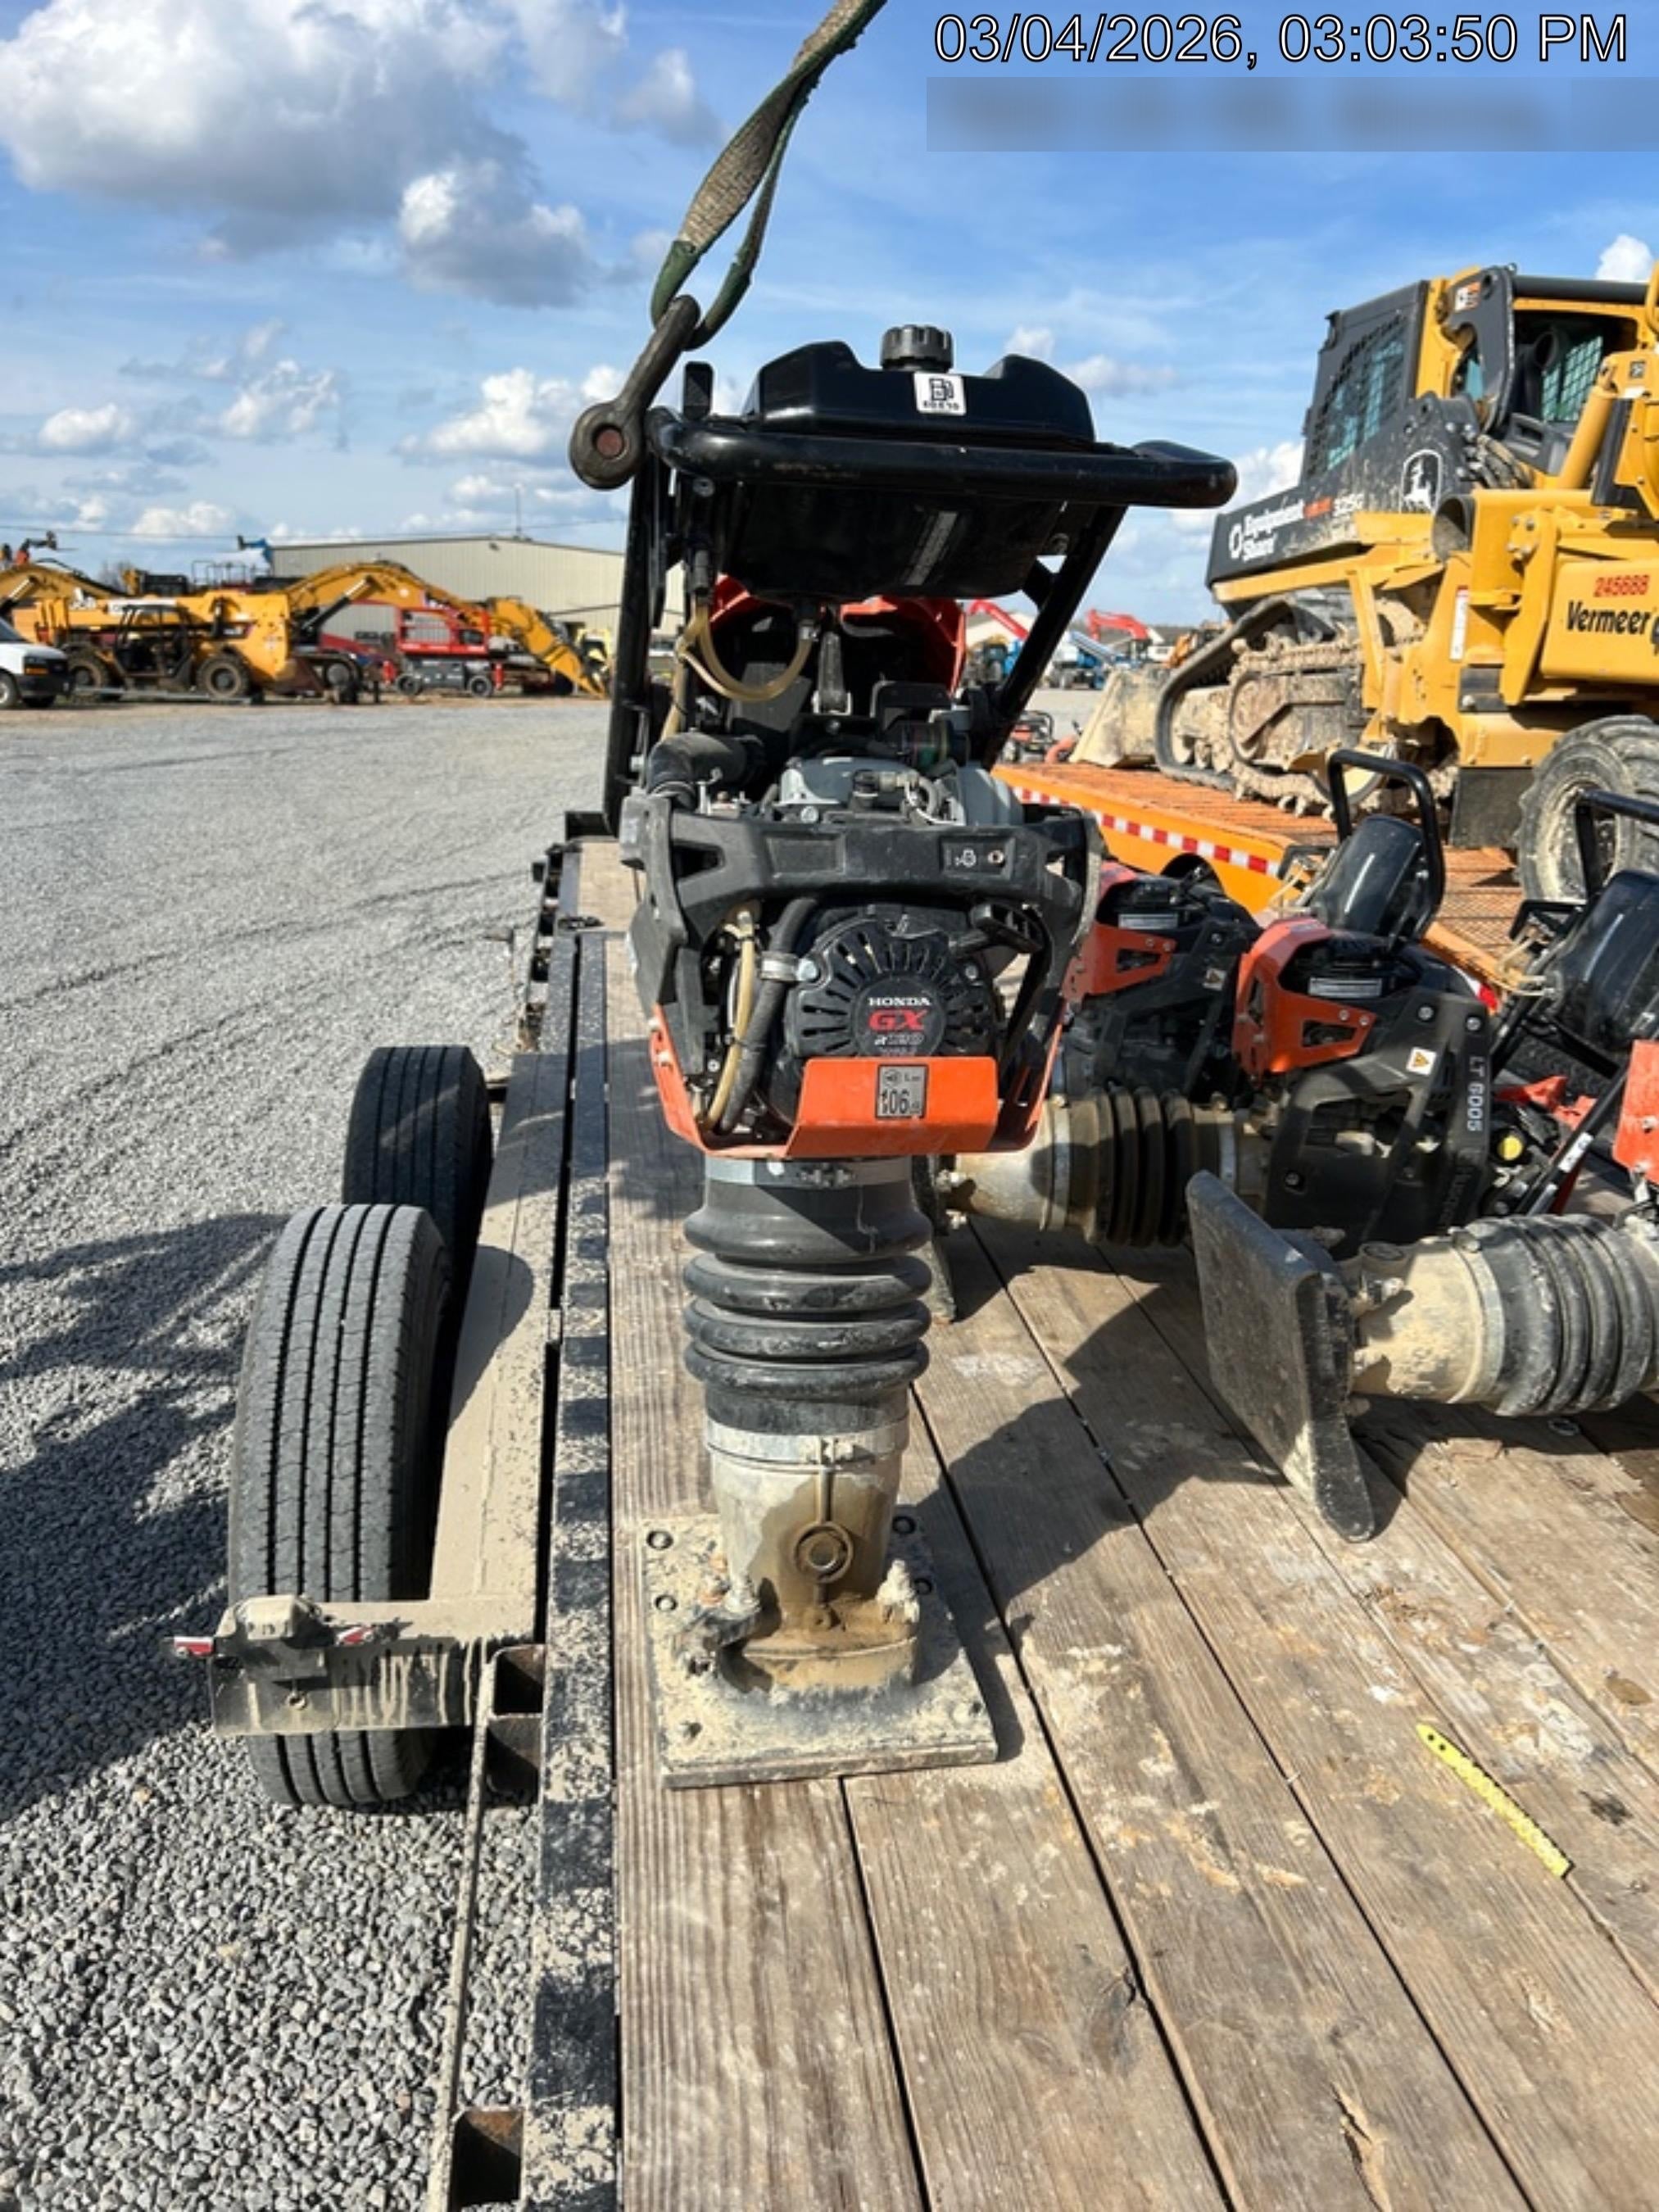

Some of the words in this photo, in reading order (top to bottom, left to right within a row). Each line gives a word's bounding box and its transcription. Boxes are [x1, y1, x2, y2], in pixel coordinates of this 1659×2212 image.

[1566, 600, 1652, 635] Vermeer
[868, 997, 931, 1006] HONDA
[868, 1009, 928, 1031] GX
[1469, 1055, 1486, 1077] LT
[882, 1088, 910, 1114] 106
[1466, 1082, 1485, 1131] 6005
